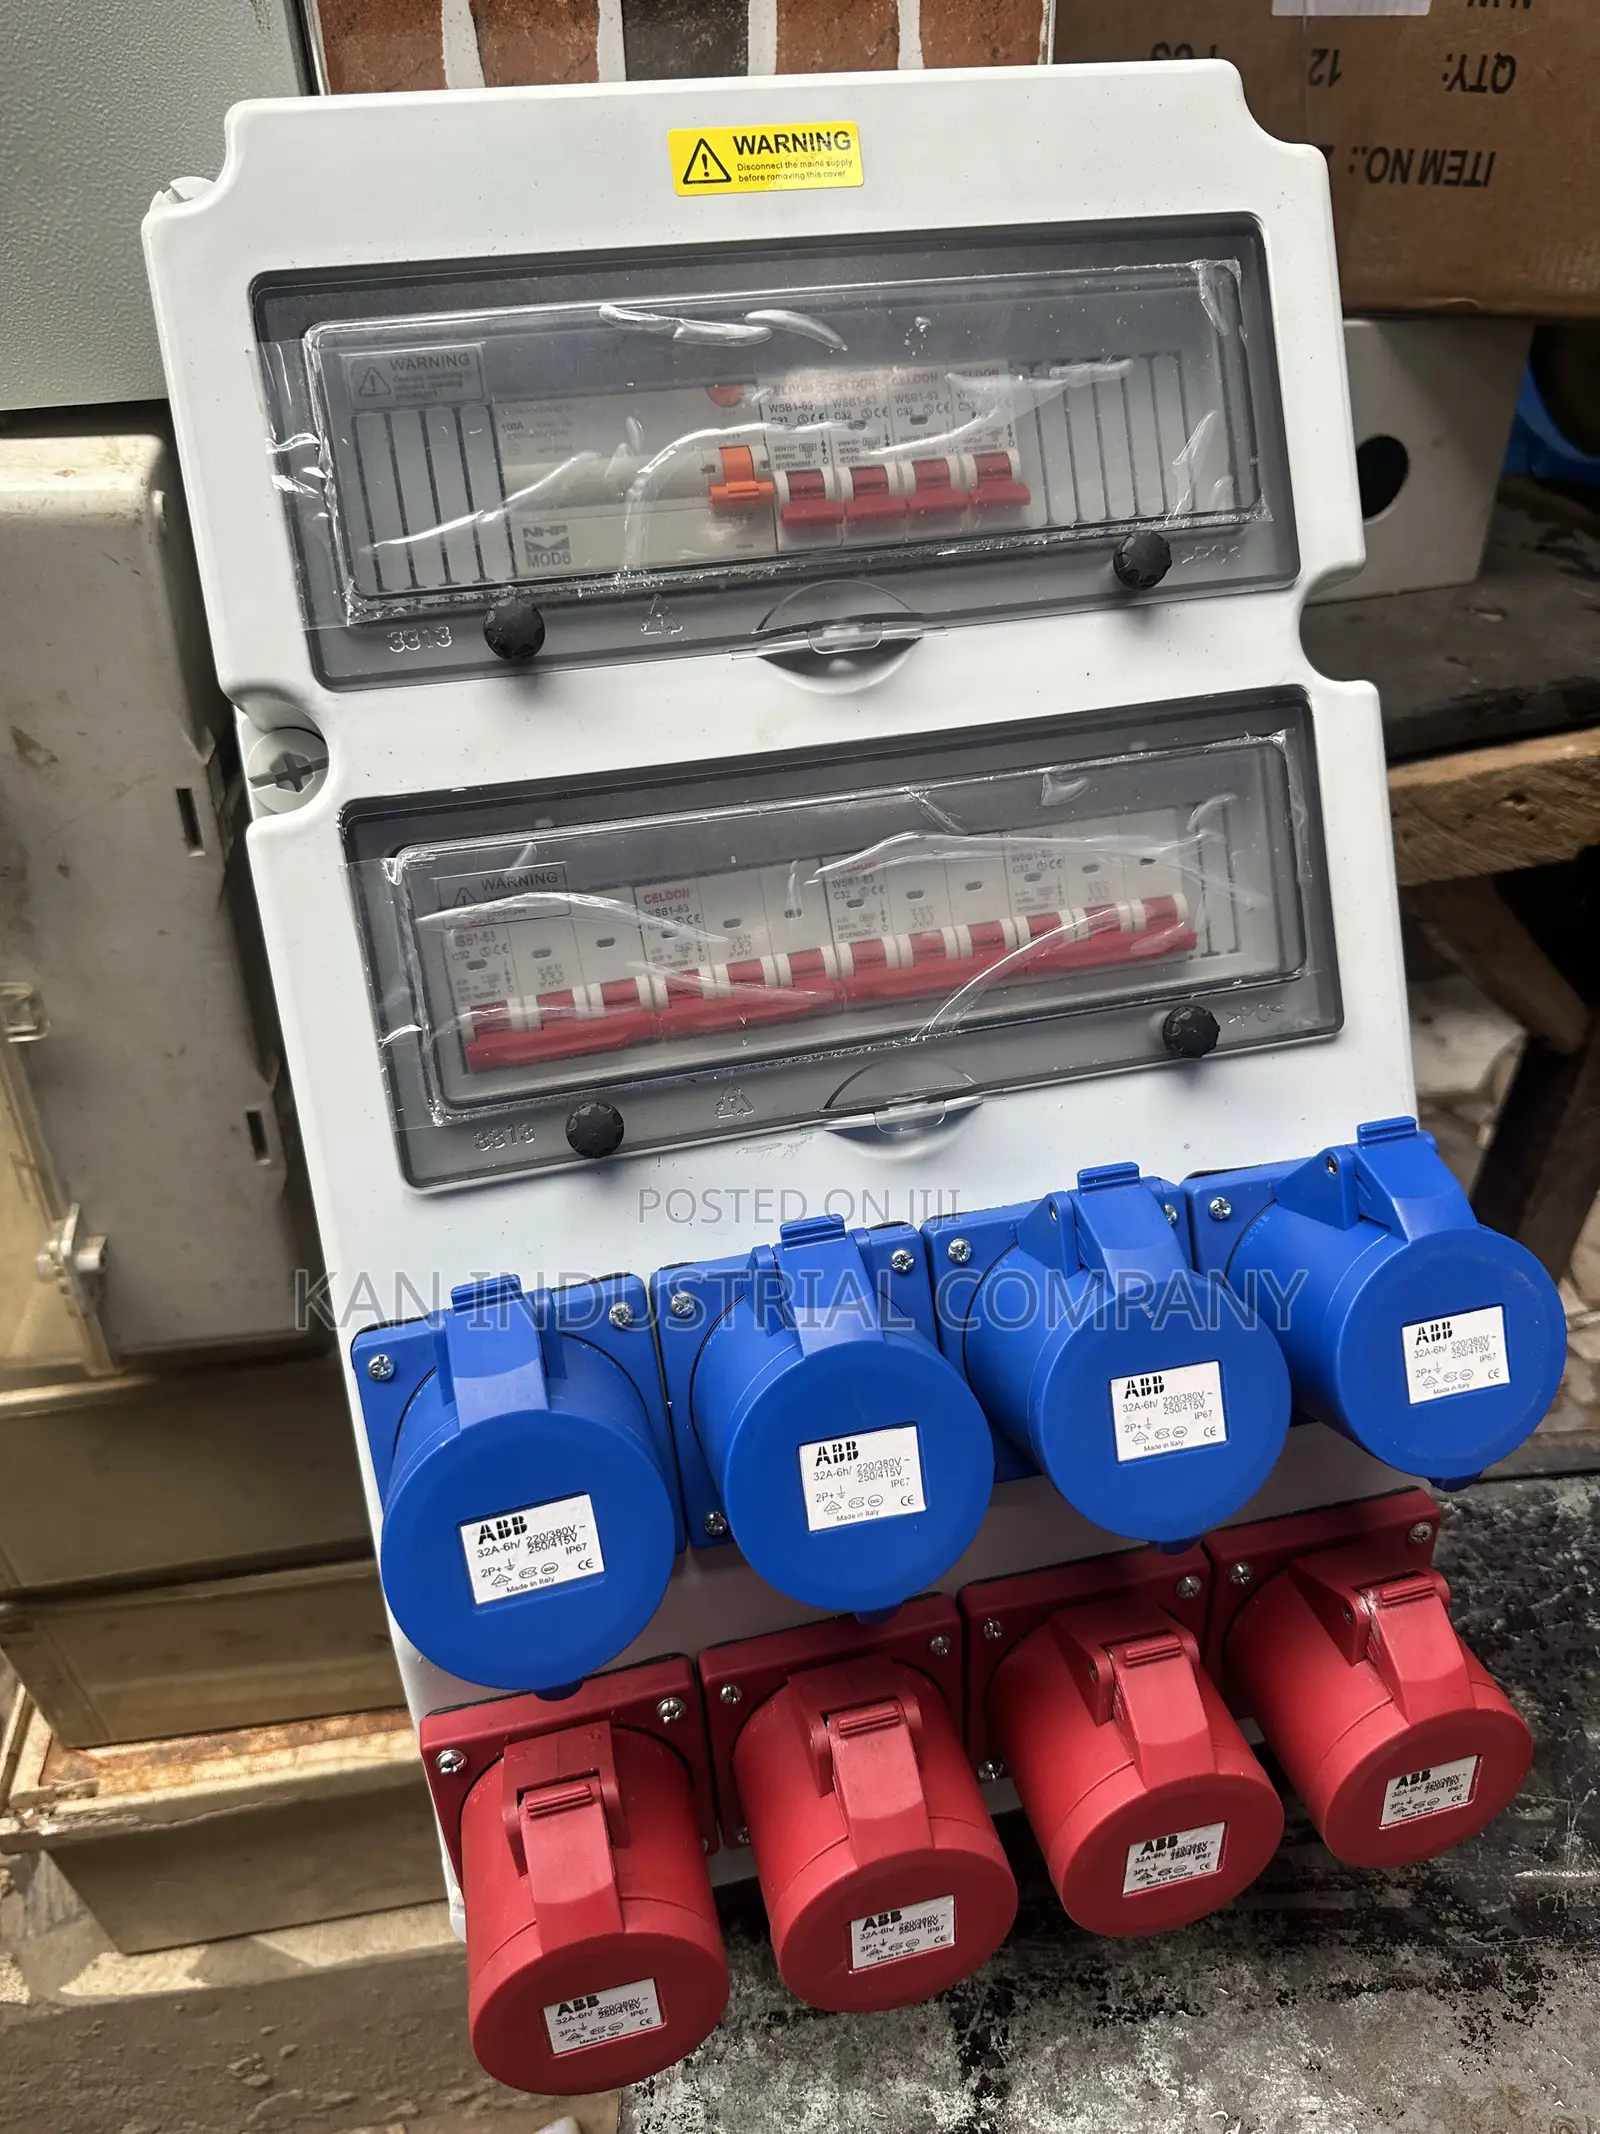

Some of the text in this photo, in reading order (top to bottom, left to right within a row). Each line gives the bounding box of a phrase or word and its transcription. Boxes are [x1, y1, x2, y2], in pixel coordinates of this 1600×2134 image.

[1307, 47, 1517, 94] QTY: 12
[732, 131, 851, 156] WARNING
[737, 159, 853, 172] Disconnect the mains supply
[1418, 149, 1496, 188] ITEM
[738, 172, 765, 183] before
[767, 172, 806, 182] removing
[807, 171, 822, 179] this
[389, 352, 471, 372] WARNING
[833, 411, 852, 421] C32
[388, 626, 453, 653] 3313
[480, 871, 558, 892] WARNING
[643, 887, 690, 905] CELDON
[473, 1122, 536, 1152] 3313
[1416, 1321, 1453, 1346] ABB
[1413, 1334, 1489, 1359] 32A-6h/ 220/380V
[1452, 1342, 1490, 1359] 250/415V
[1479, 1352, 1497, 1363] IP67
[1124, 1375, 1165, 1400] ABB
[1433, 1387, 1450, 1395] Made
[1457, 1382, 1470, 1390] Italy
[1122, 1391, 1205, 1414] 32A-6h/ 220/380V
[1163, 1399, 1206, 1415] 250/415V
[1194, 1409, 1213, 1420] IP67
[815, 1440, 859, 1467] ABB
[1143, 1443, 1162, 1452] Made
[1170, 1440, 1185, 1448] Italy
[813, 1457, 902, 1482] 32A-6h/ 220/380V
[857, 1466, 903, 1483] 250/415V
[836, 1514, 856, 1522] Made
[865, 1509, 880, 1518] Italy
[478, 1515, 528, 1545] ABB
[476, 1524, 576, 1559] 32A-6h/ 220/380V
[527, 1532, 578, 1555] 250/415V
[565, 1542, 588, 1556] IP67
[506, 1575, 555, 1594] Made in Italy
[1395, 1768, 1432, 1790] ABB
[1140, 1834, 1179, 1855] ABB
[861, 1910, 903, 1932] ABB
[557, 1994, 601, 2017] ABB
